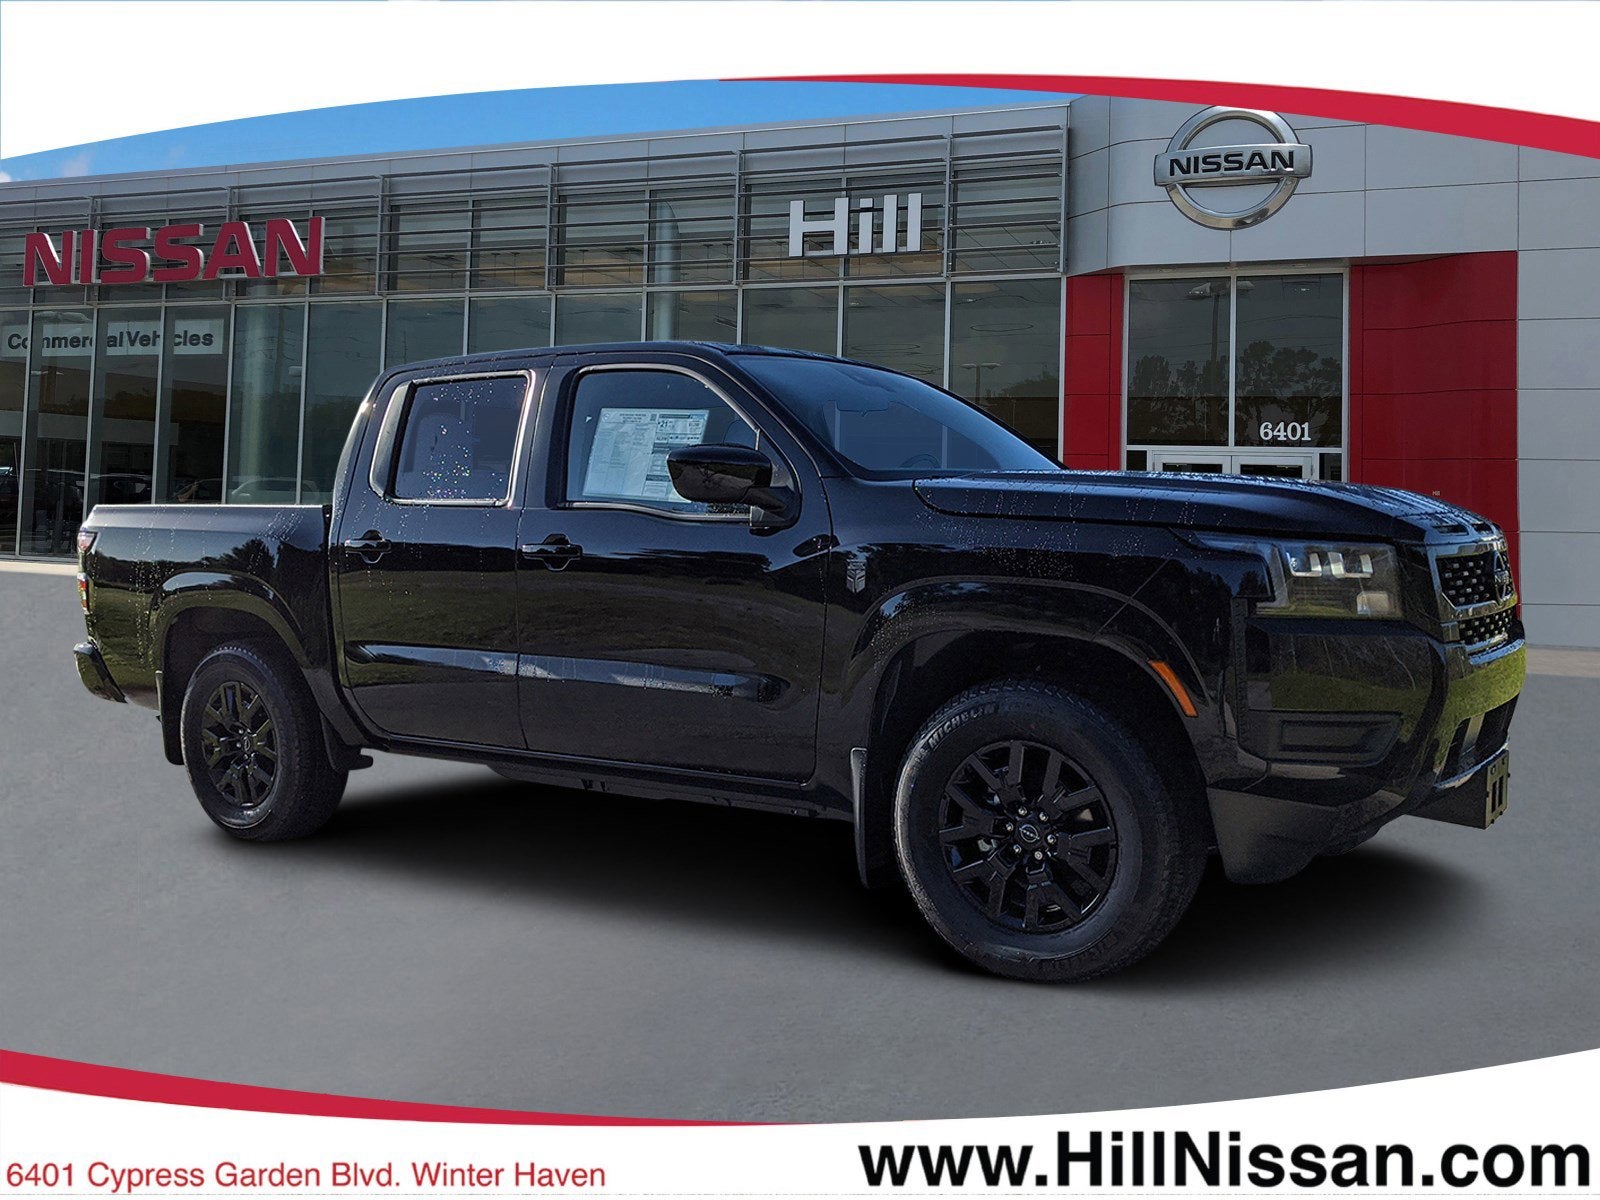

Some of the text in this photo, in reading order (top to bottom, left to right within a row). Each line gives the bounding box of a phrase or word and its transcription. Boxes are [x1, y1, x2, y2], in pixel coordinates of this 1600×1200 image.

[1170, 150, 1295, 176] NISSAN
[789, 192, 922, 257] Hill
[23, 216, 326, 287] NISSAN
[126, 329, 214, 347] Vehcles
[1259, 422, 1312, 441] 6401
